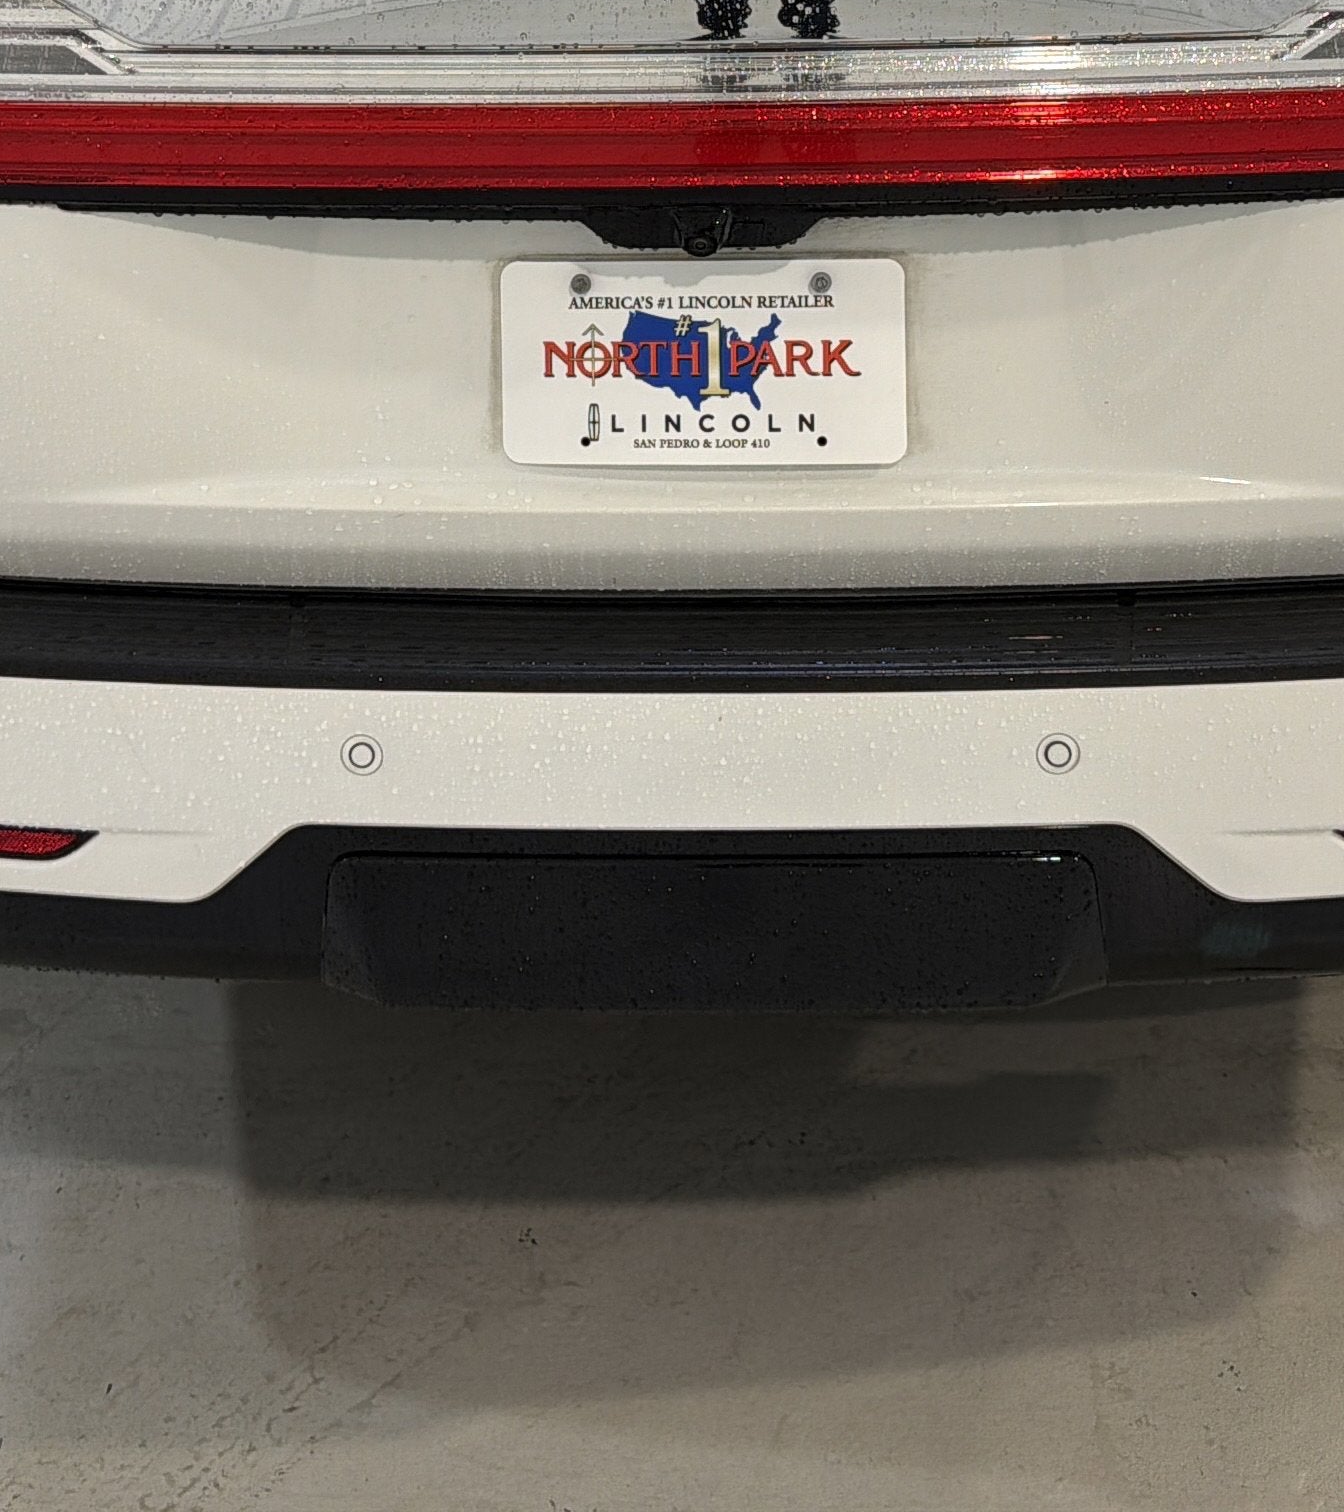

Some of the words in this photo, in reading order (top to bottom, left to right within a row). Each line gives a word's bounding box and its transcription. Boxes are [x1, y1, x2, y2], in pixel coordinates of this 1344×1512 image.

[568, 296, 653, 310] AMERICA'S
[657, 297, 673, 309] #1
[679, 296, 753, 310] LINCOLN
[757, 295, 834, 309] RETAILER
[543, 340, 701, 379] NORTH
[728, 339, 862, 377] PARK
[611, 414, 815, 433] LINCOLN
[633, 438, 656, 449] SAN
[659, 438, 700, 449] PEDRO
[704, 438, 712, 448] &
[715, 438, 748, 449] LOOP
[750, 438, 771, 448] 410
